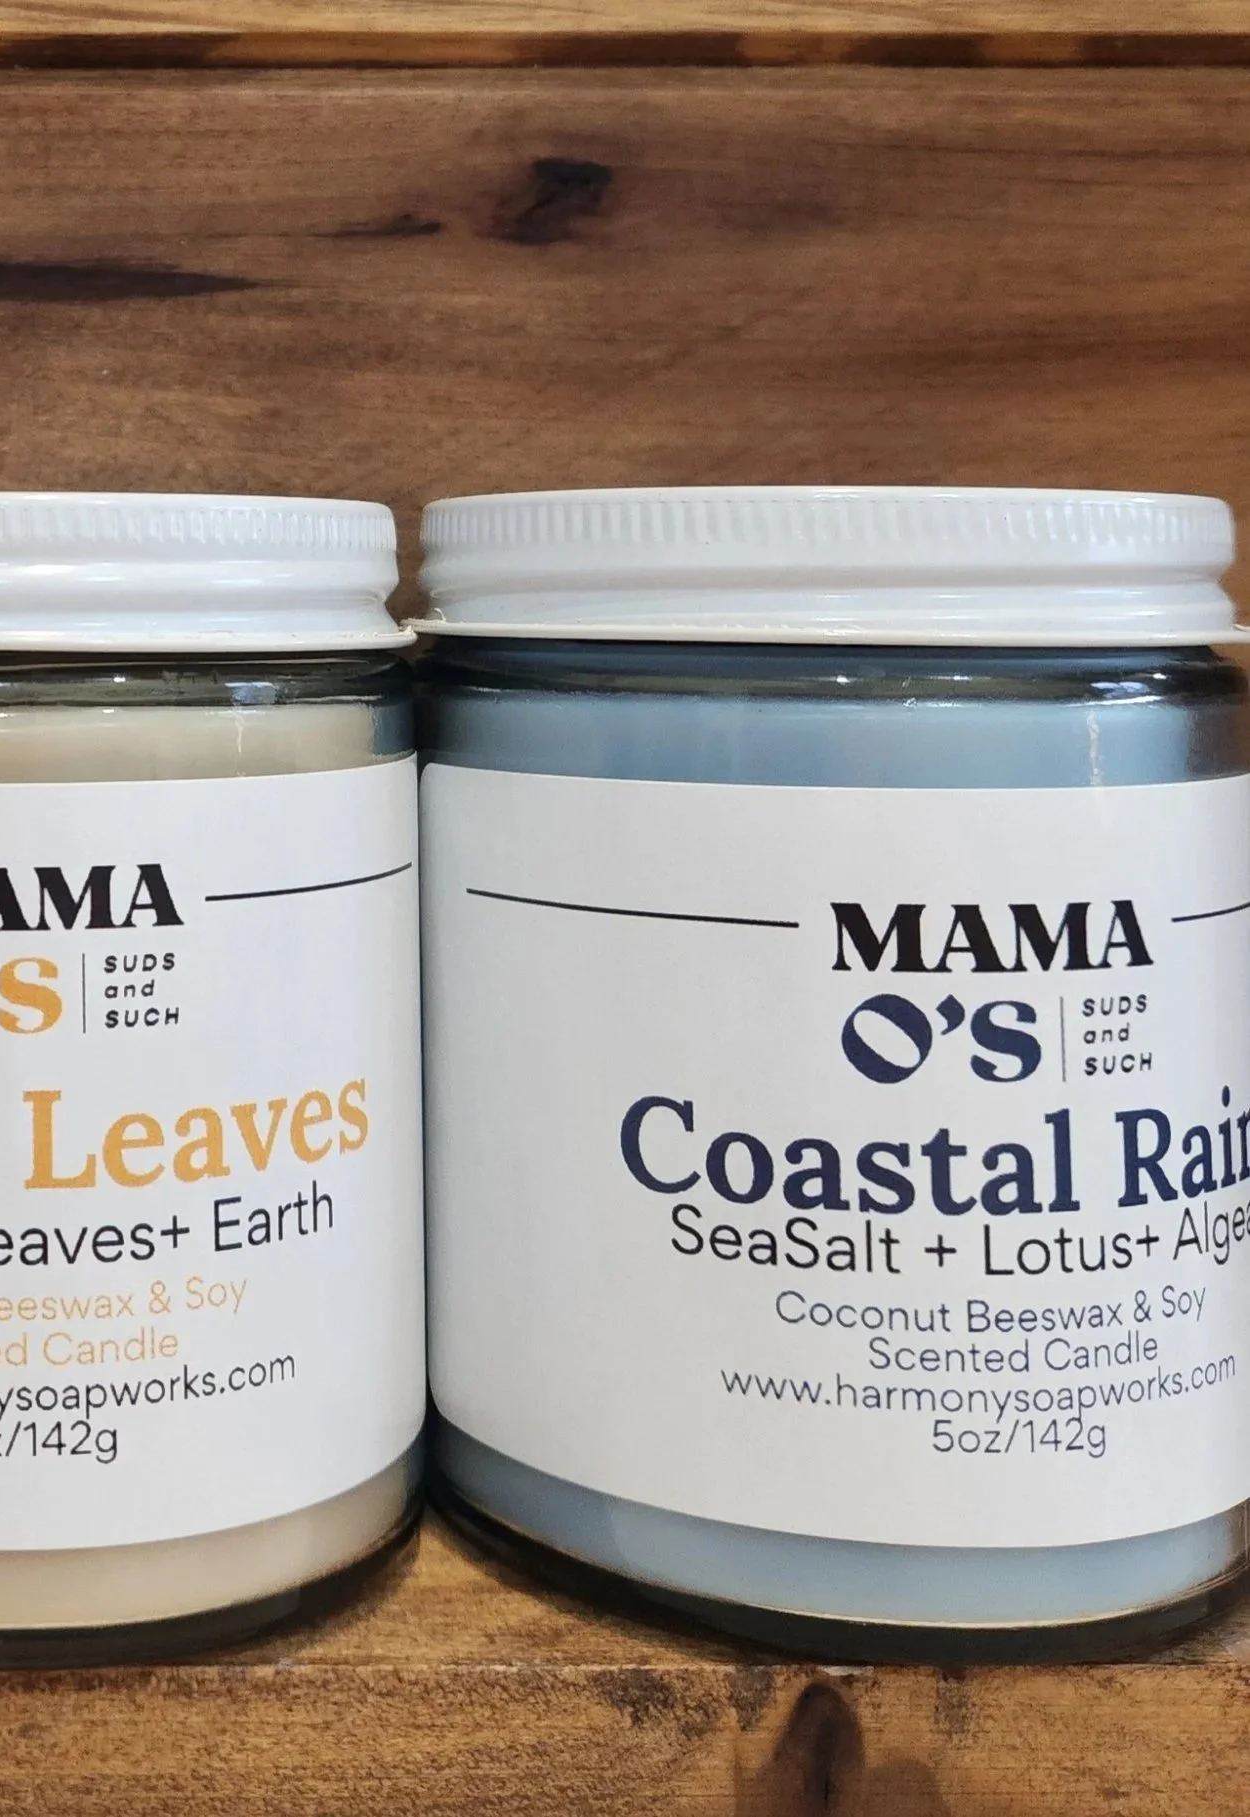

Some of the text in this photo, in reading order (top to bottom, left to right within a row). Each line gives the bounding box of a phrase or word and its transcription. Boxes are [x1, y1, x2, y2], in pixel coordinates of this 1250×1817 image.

[830, 899, 1154, 973] MAMA
[104, 953, 176, 974] SUDS
[104, 979, 156, 999] and
[1082, 994, 1147, 1018] SUDS
[105, 1007, 180, 1029] SUCH
[1082, 1022, 1131, 1044] and
[1084, 1052, 1152, 1077] SUCH
[23, 1078, 368, 1190] Leaves
[620, 1096, 1080, 1217] Coastal
[214, 1180, 334, 1253] Earth
[671, 1203, 901, 1275] SeaSalt
[924, 1234, 957, 1268] +
[149, 1280, 171, 1315] &
[185, 1275, 247, 1313] Soy
[775, 1284, 1207, 1334] Coconut Beeswax & Soy
[42, 1327, 179, 1366] Candle
[868, 1330, 1158, 1374] Scented Candle
[721, 1354, 1236, 1424] www.harmonysoapworks.com
[932, 1419, 1107, 1459] 5oz/142g
